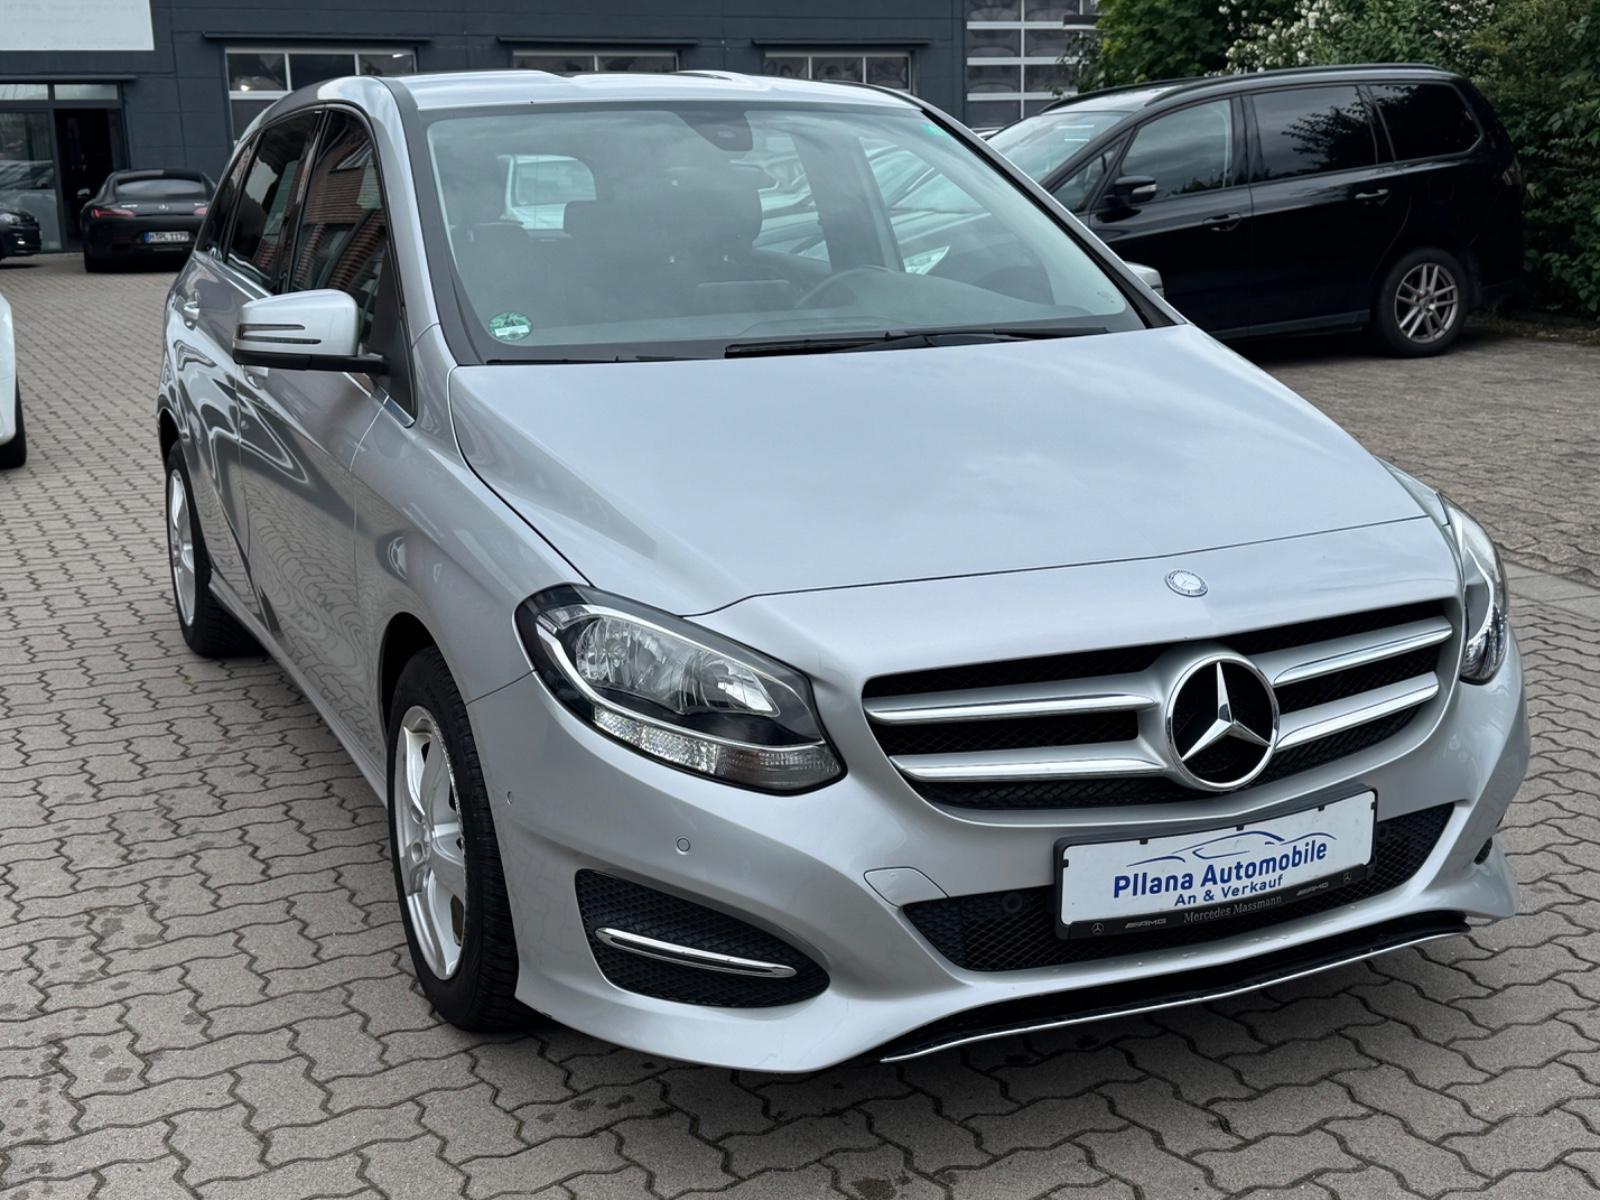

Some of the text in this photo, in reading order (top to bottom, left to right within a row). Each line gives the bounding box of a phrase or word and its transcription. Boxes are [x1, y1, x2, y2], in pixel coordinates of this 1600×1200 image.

[1200, 840, 1328, 888] Automobile
[1174, 874, 1283, 907] An & Verkauf
[1183, 896, 1282, 923] Mercedes Massmann
